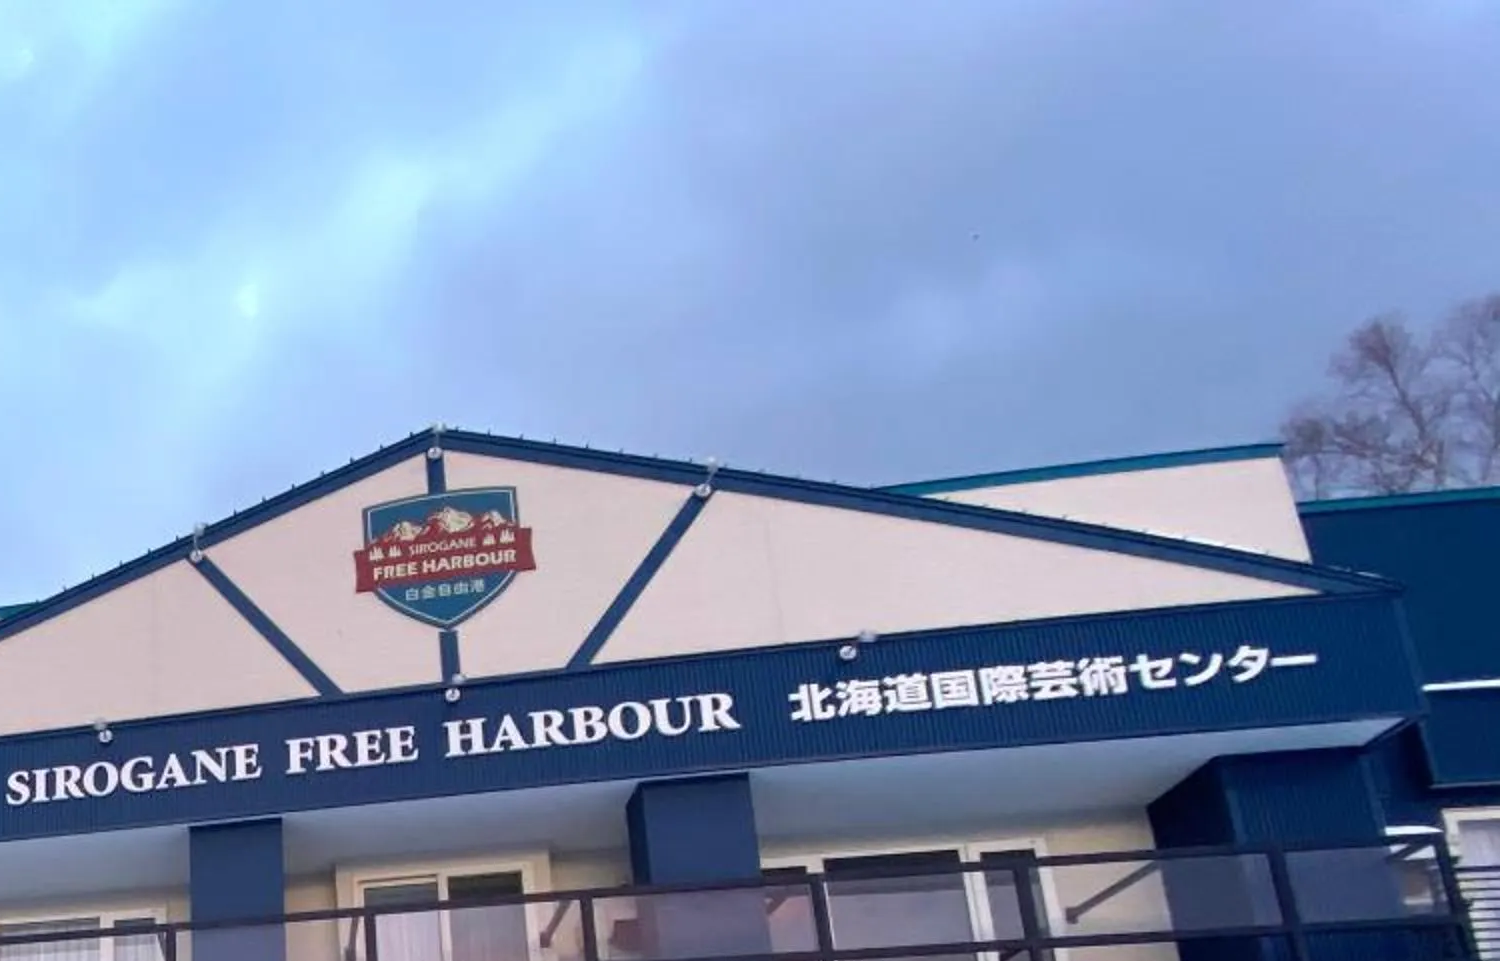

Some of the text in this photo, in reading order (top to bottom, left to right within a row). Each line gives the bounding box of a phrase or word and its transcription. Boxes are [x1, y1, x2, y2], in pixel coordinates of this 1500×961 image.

[409, 537, 477, 556] SIROGANE
[373, 549, 517, 580] FREE HARBOUR
[405, 578, 485, 601] 白金自由港
[788, 645, 1318, 721] 北海道国際芸術センター
[6, 692, 741, 805] SIROGANE FREE HARBOUR
